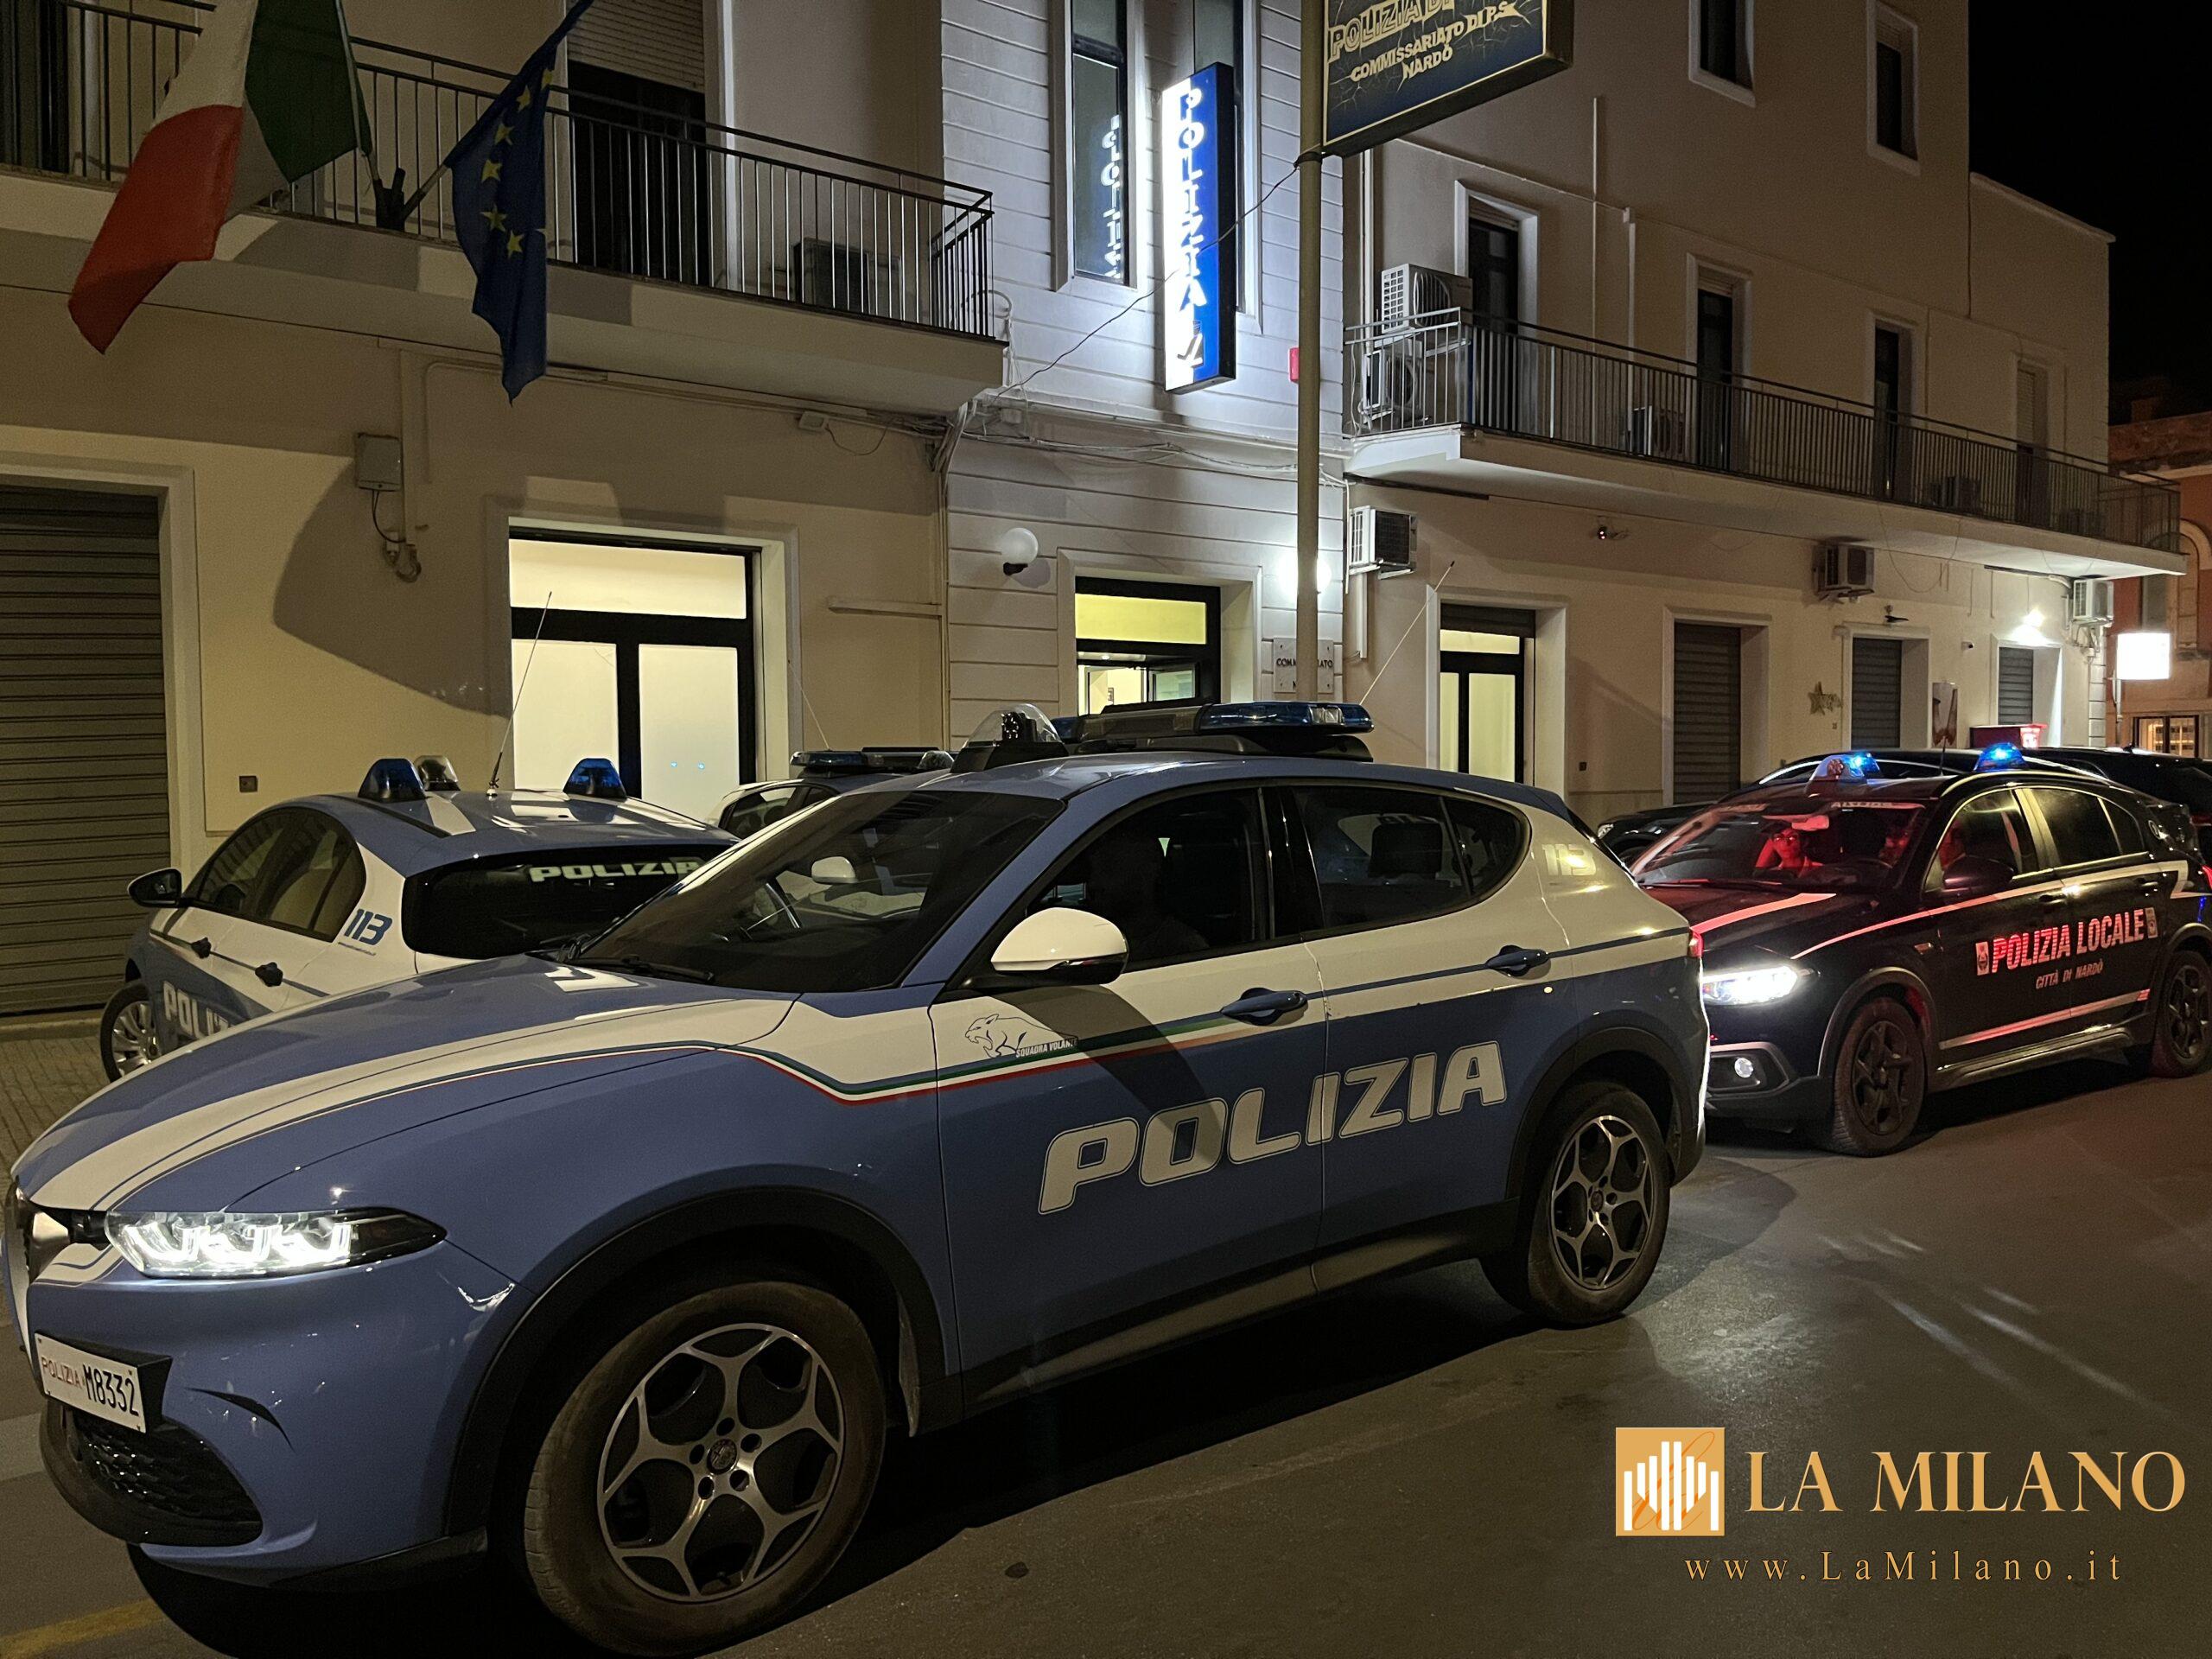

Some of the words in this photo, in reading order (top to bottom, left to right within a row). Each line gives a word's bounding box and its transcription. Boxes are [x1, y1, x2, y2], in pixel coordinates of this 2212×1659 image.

[1327, 0, 1424, 63] POLIZIA
[1351, 21, 1465, 82] COMMISSARIATO
[1402, 43, 1452, 79] NARDÒ
[1178, 87, 1207, 313] POLIZIA
[528, 861, 702, 882] POLIZIA
[344, 908, 393, 946] 113
[1991, 925, 2071, 974] POLIZIA
[2075, 908, 2145, 955] LOCALE
[2063, 968, 2073, 982] DI
[1015, 1044, 1048, 1058] SQUADRA
[1039, 1041, 1507, 1215] POLIZIA
[41, 1357, 83, 1389] POLIZIA
[83, 1363, 140, 1417] M8332
